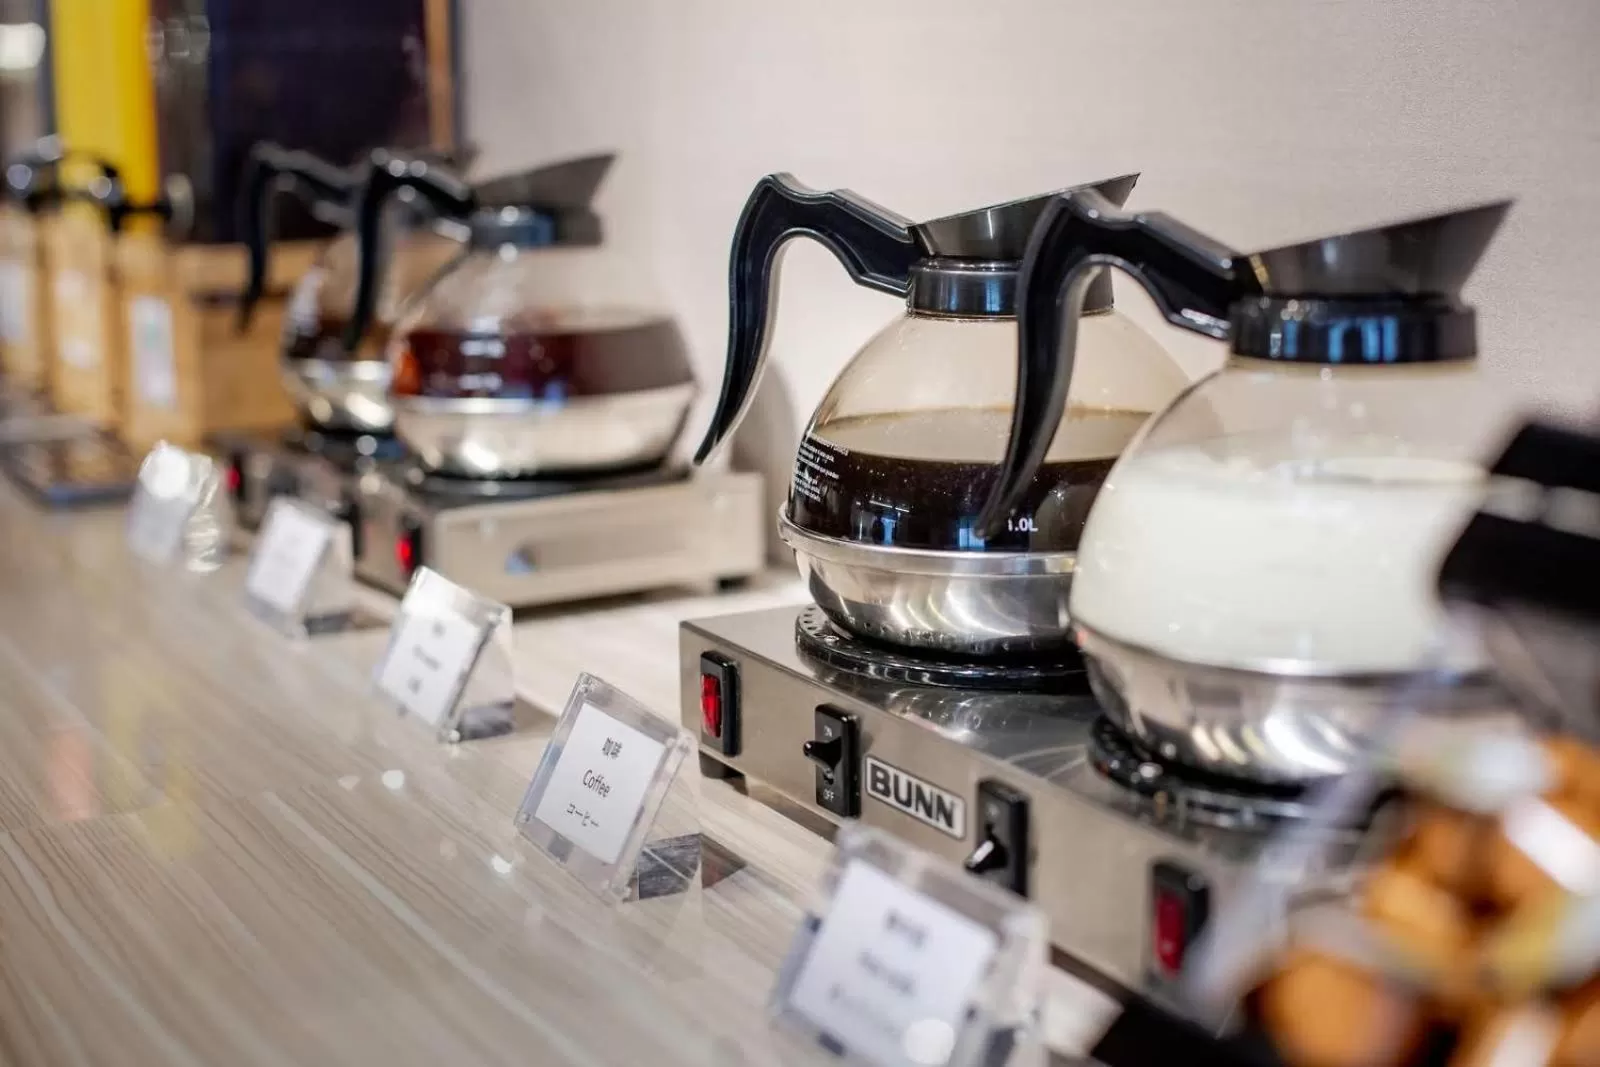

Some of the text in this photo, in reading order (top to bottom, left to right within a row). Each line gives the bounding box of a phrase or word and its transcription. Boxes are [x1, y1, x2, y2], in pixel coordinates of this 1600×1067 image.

[1008, 517, 1040, 532] 1.0L
[582, 769, 611, 798] Coffee
[823, 787, 835, 802] OFF
[869, 765, 956, 830] BUNN
